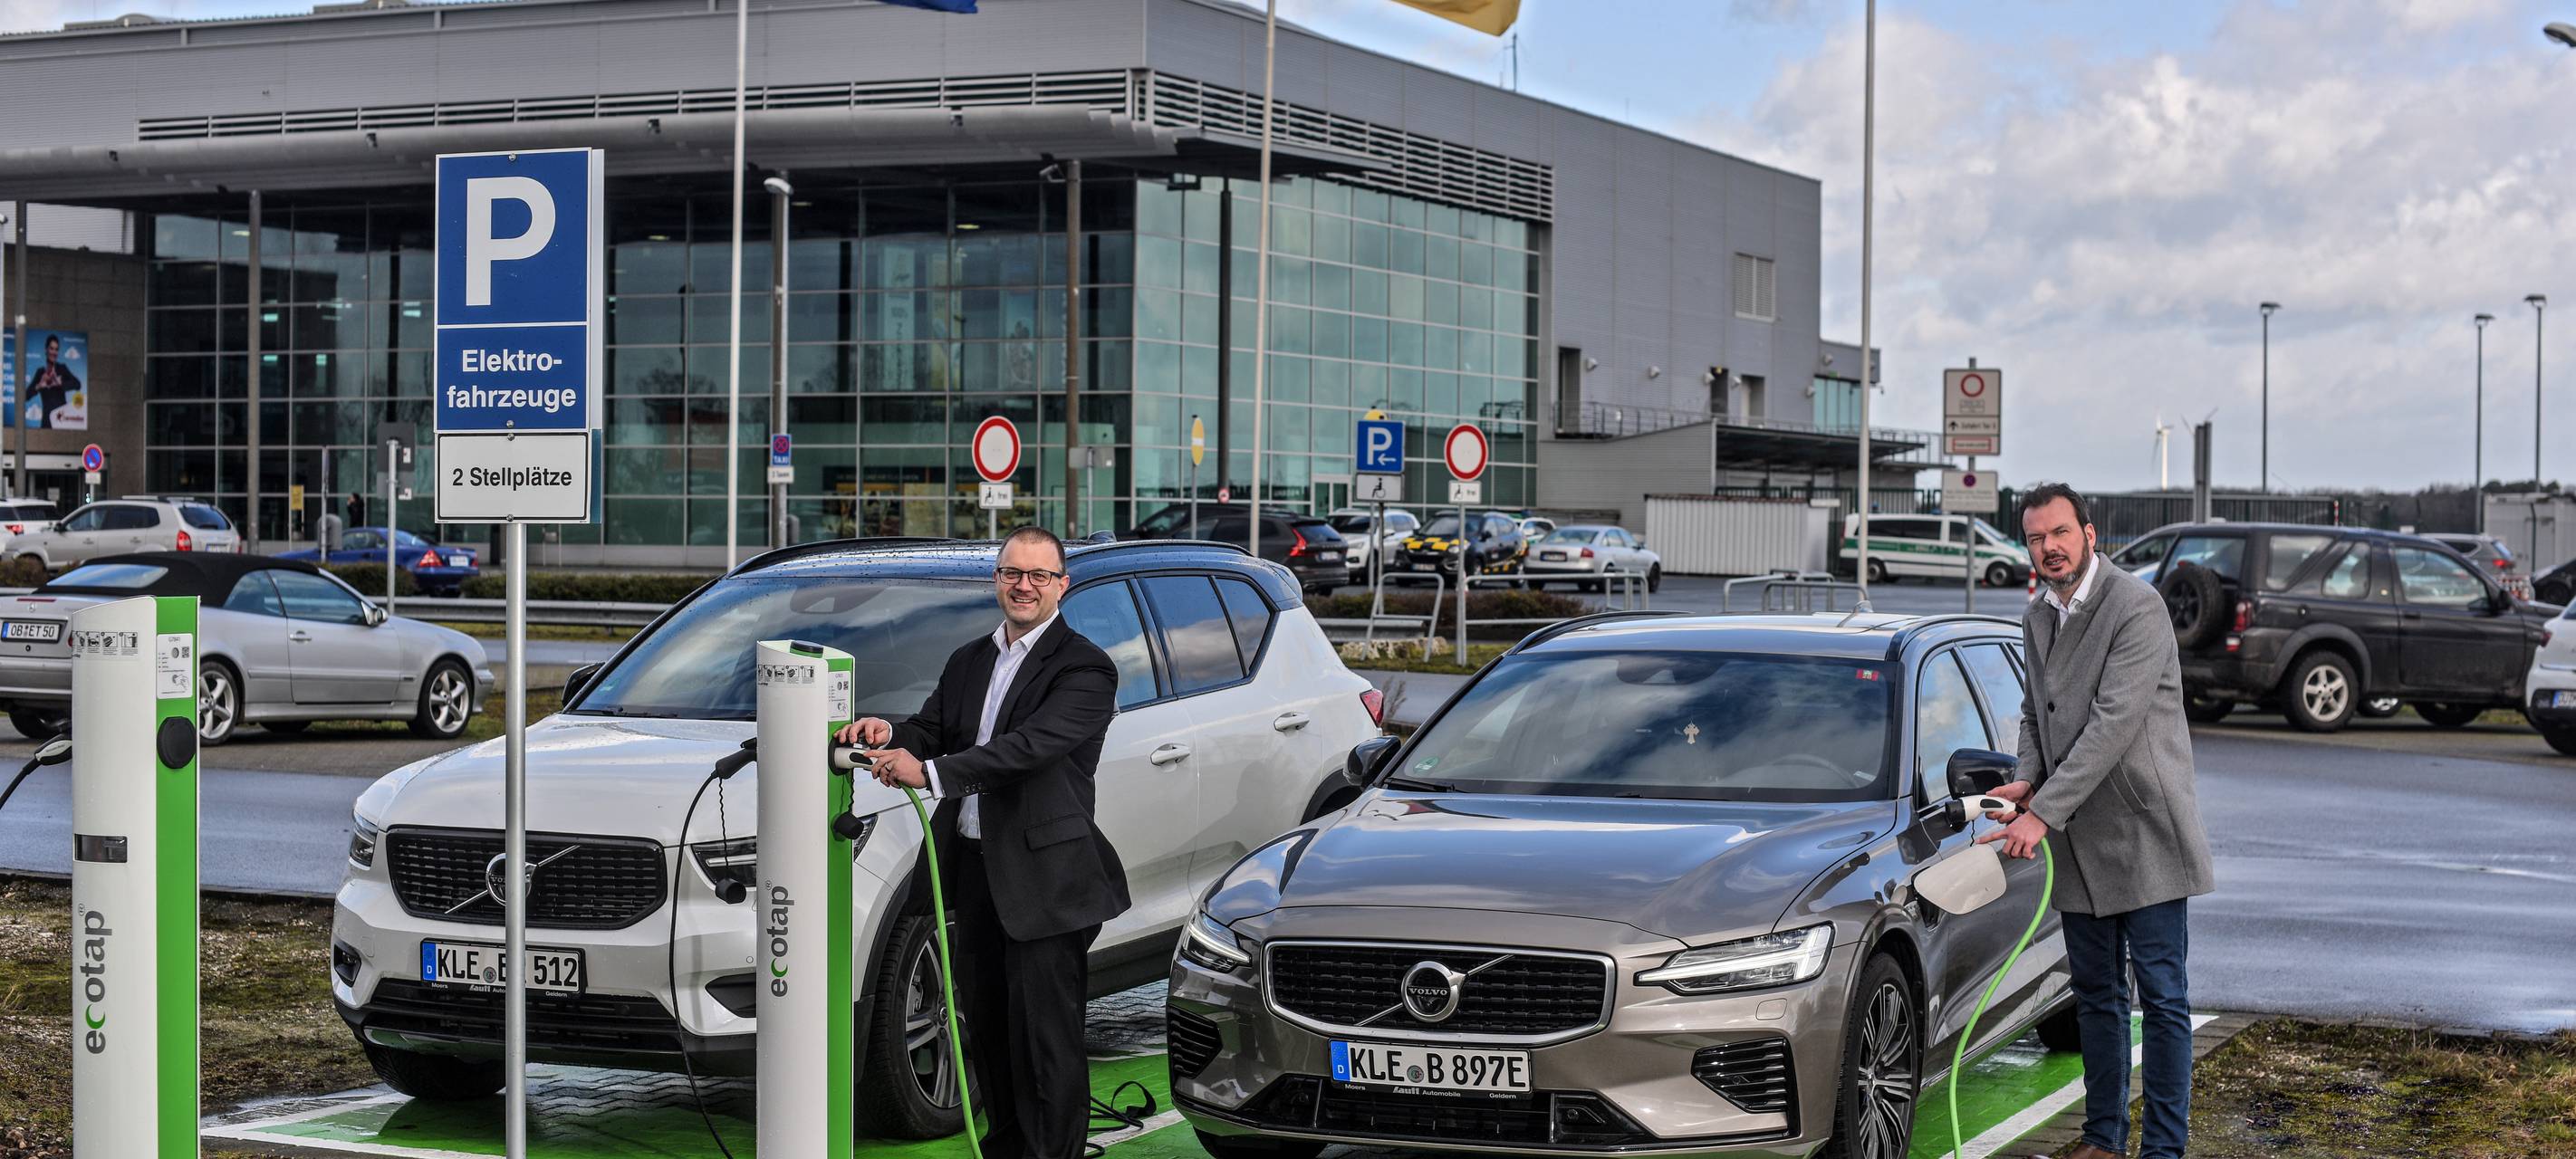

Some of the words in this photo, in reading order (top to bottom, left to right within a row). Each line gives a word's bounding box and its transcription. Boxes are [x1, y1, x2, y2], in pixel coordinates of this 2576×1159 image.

[466, 176, 556, 307] P
[462, 349, 562, 372] Elektro-
[447, 385, 577, 413] fahrzeuge
[1367, 426, 1393, 465] P
[452, 467, 464, 487] 2
[470, 465, 572, 491] Stellplätze
[43, 626, 54, 637] 50
[437, 948, 480, 980] KLE
[534, 955, 578, 987] 512
[1408, 987, 1448, 996] VOLVO
[1350, 1048, 1405, 1082] KLE
[1427, 1052, 1445, 1084] B
[1452, 1054, 1526, 1087] 897E
[1422, 1089, 1461, 1097] Automobile
